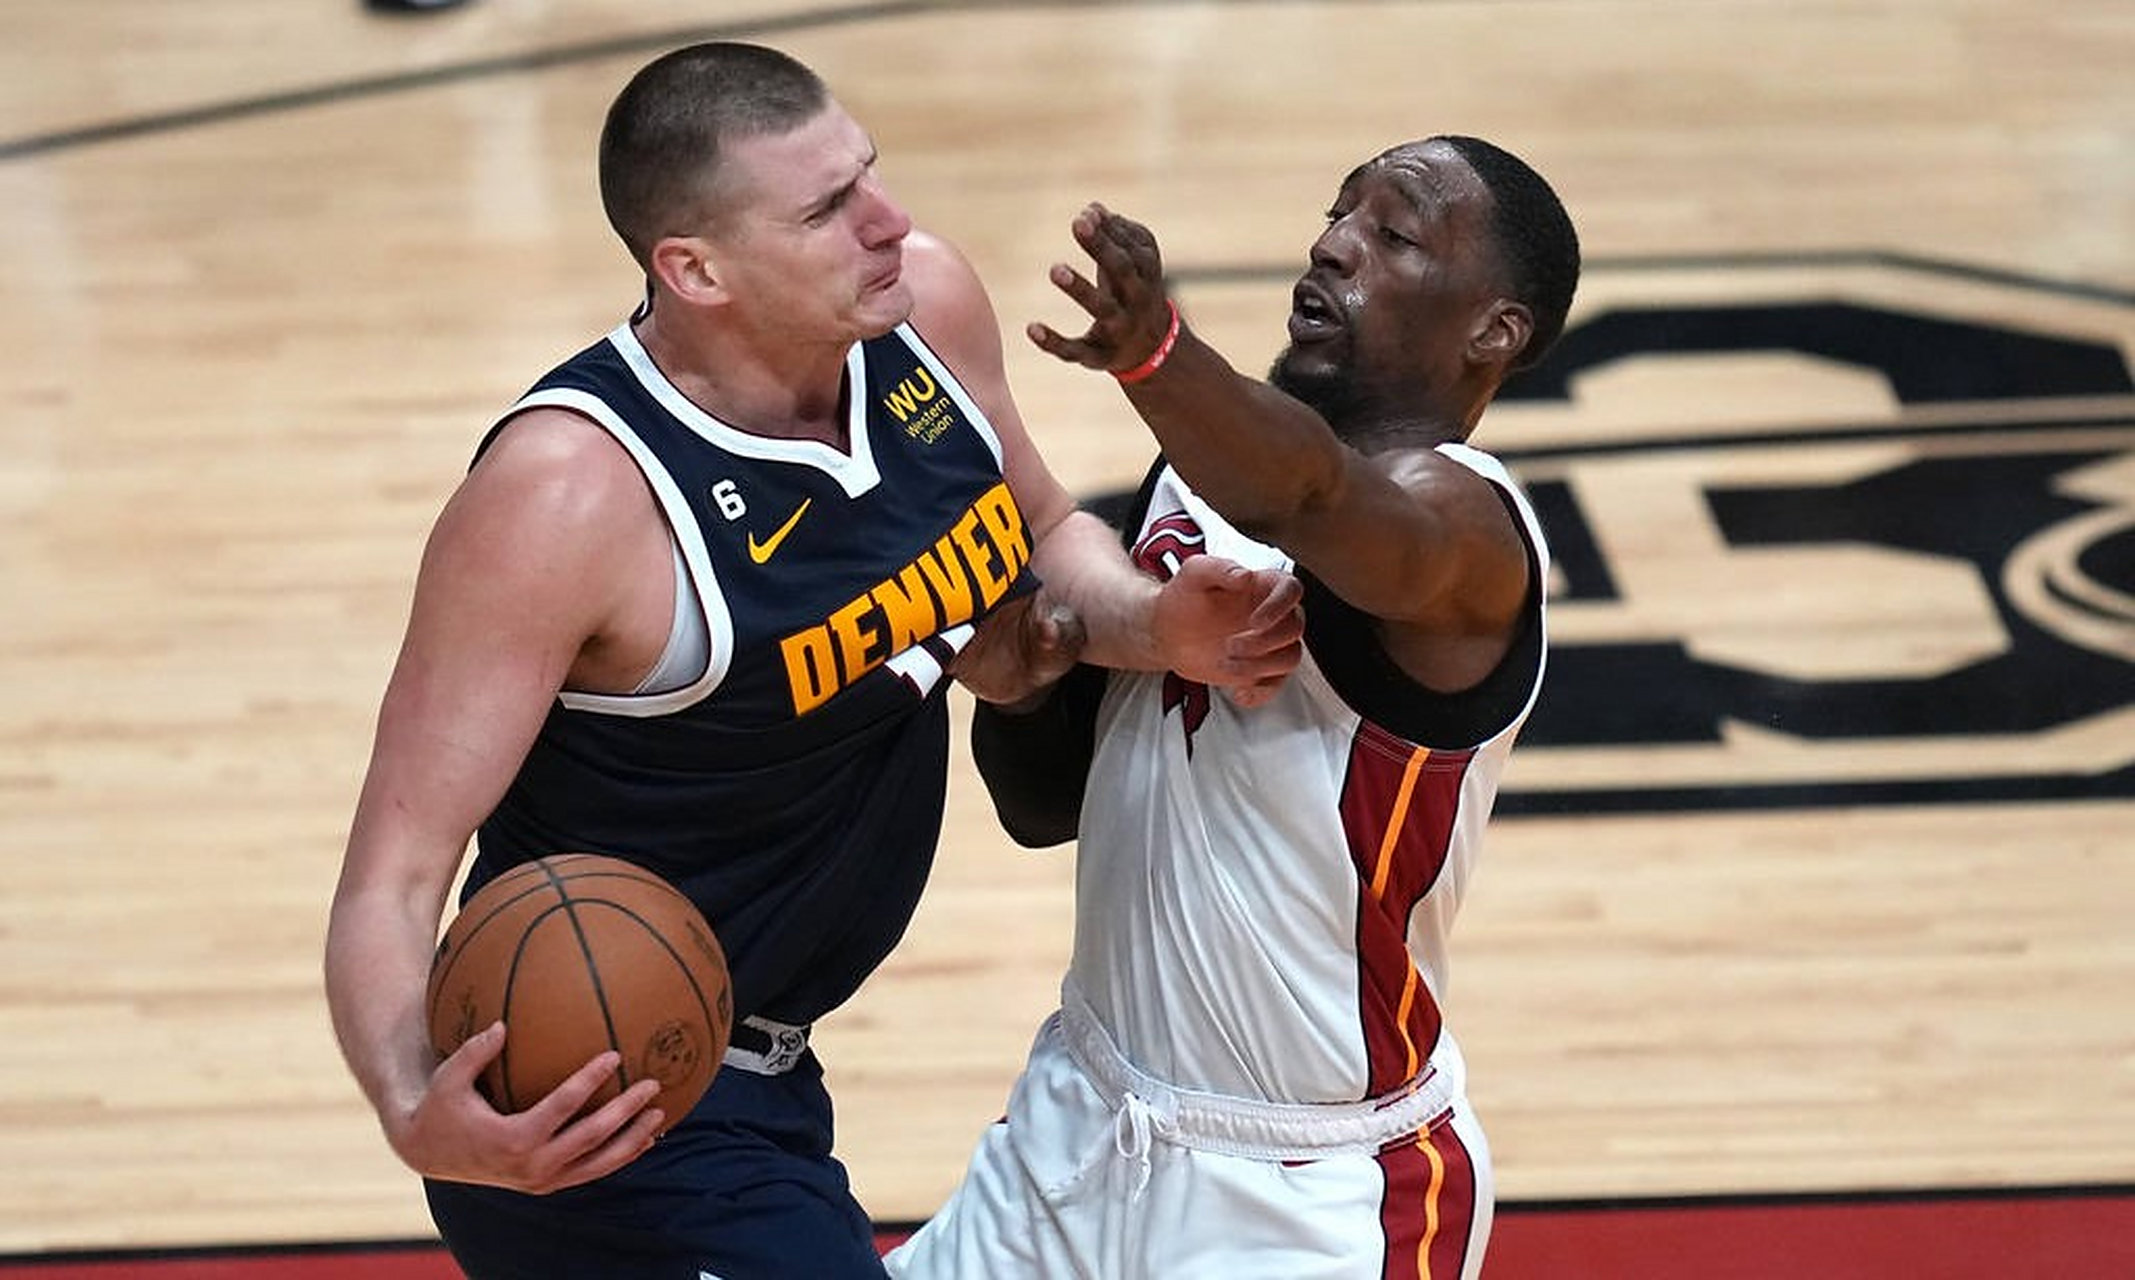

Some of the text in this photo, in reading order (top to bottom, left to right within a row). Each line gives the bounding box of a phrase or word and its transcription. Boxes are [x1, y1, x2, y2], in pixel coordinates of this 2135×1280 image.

[884, 367, 935, 421] WU
[905, 397, 951, 437] Western
[921, 415, 954, 444] Union
[712, 480, 747, 520] 6
[780, 482, 1029, 715] DENVER
